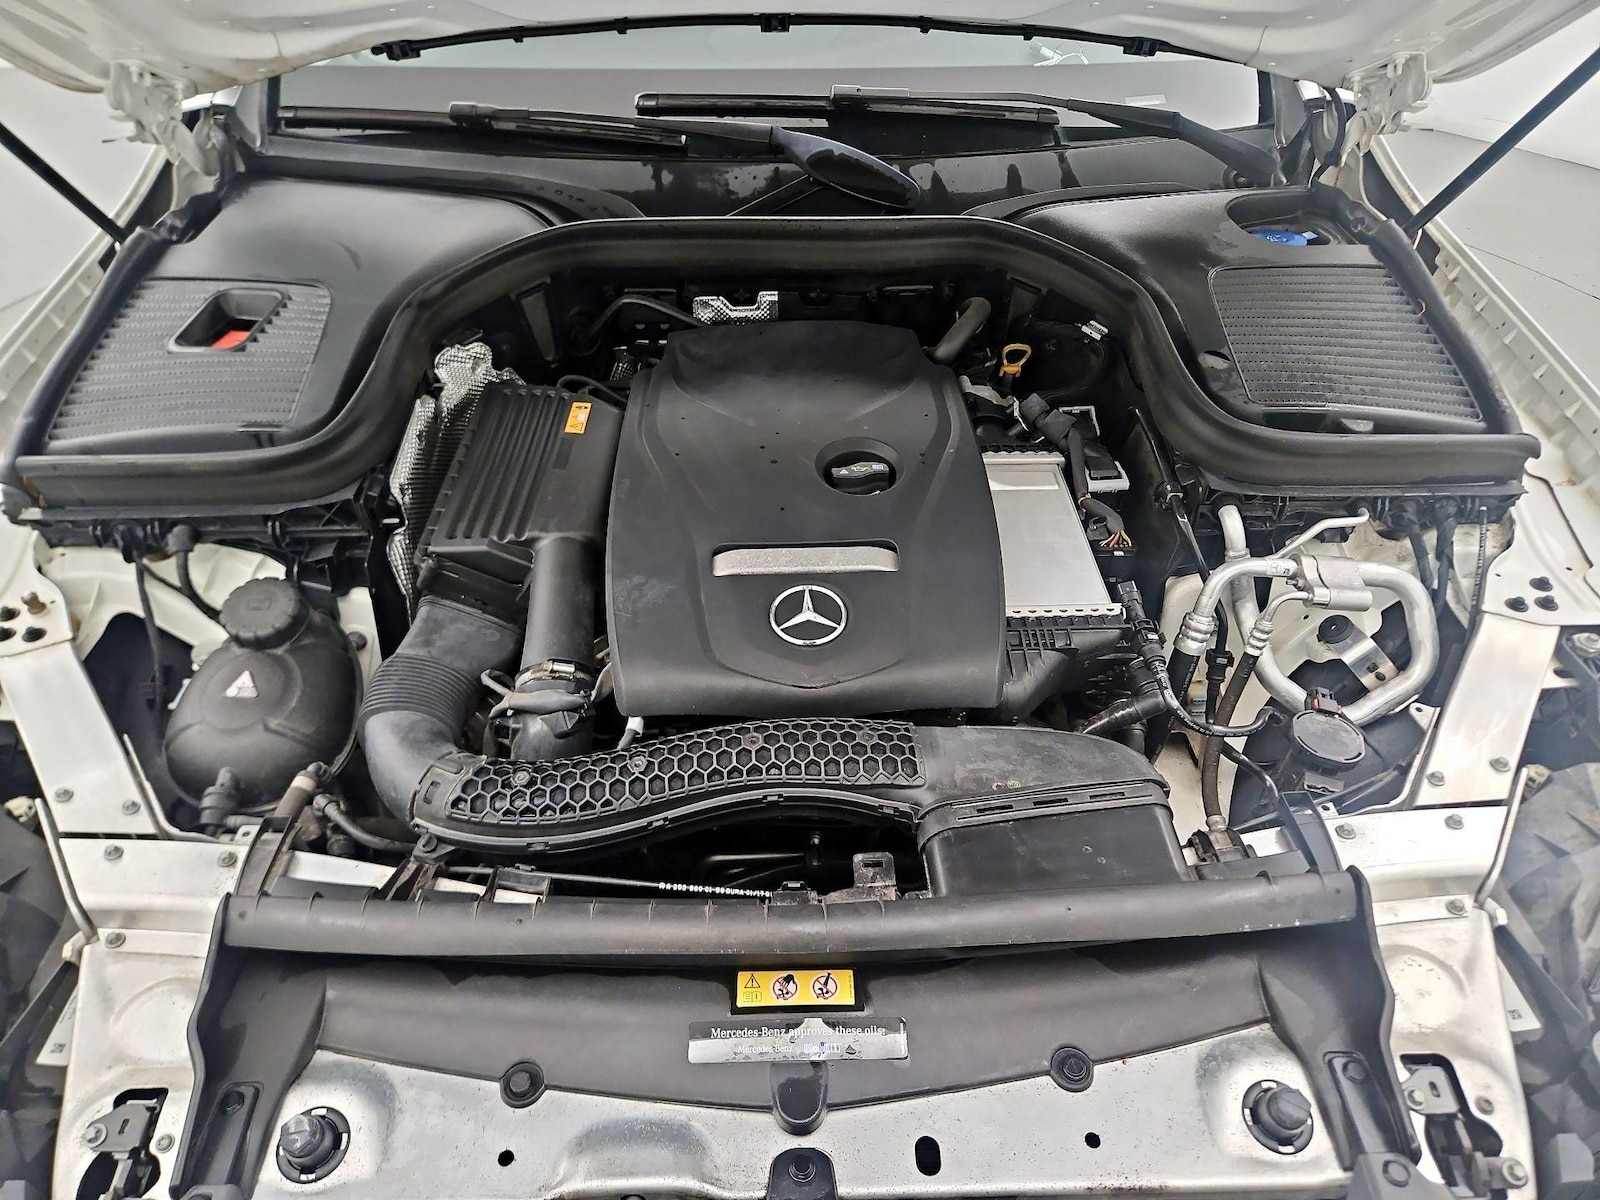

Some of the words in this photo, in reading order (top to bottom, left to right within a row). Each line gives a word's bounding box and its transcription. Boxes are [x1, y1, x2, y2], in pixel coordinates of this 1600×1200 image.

[710, 1026, 786, 1039] Mercedes-Benz
[788, 1027, 833, 1039] approves
[835, 1025, 862, 1036] these
[864, 1024, 886, 1036] oils:
[738, 1044, 794, 1054] Mercedes-Benz
